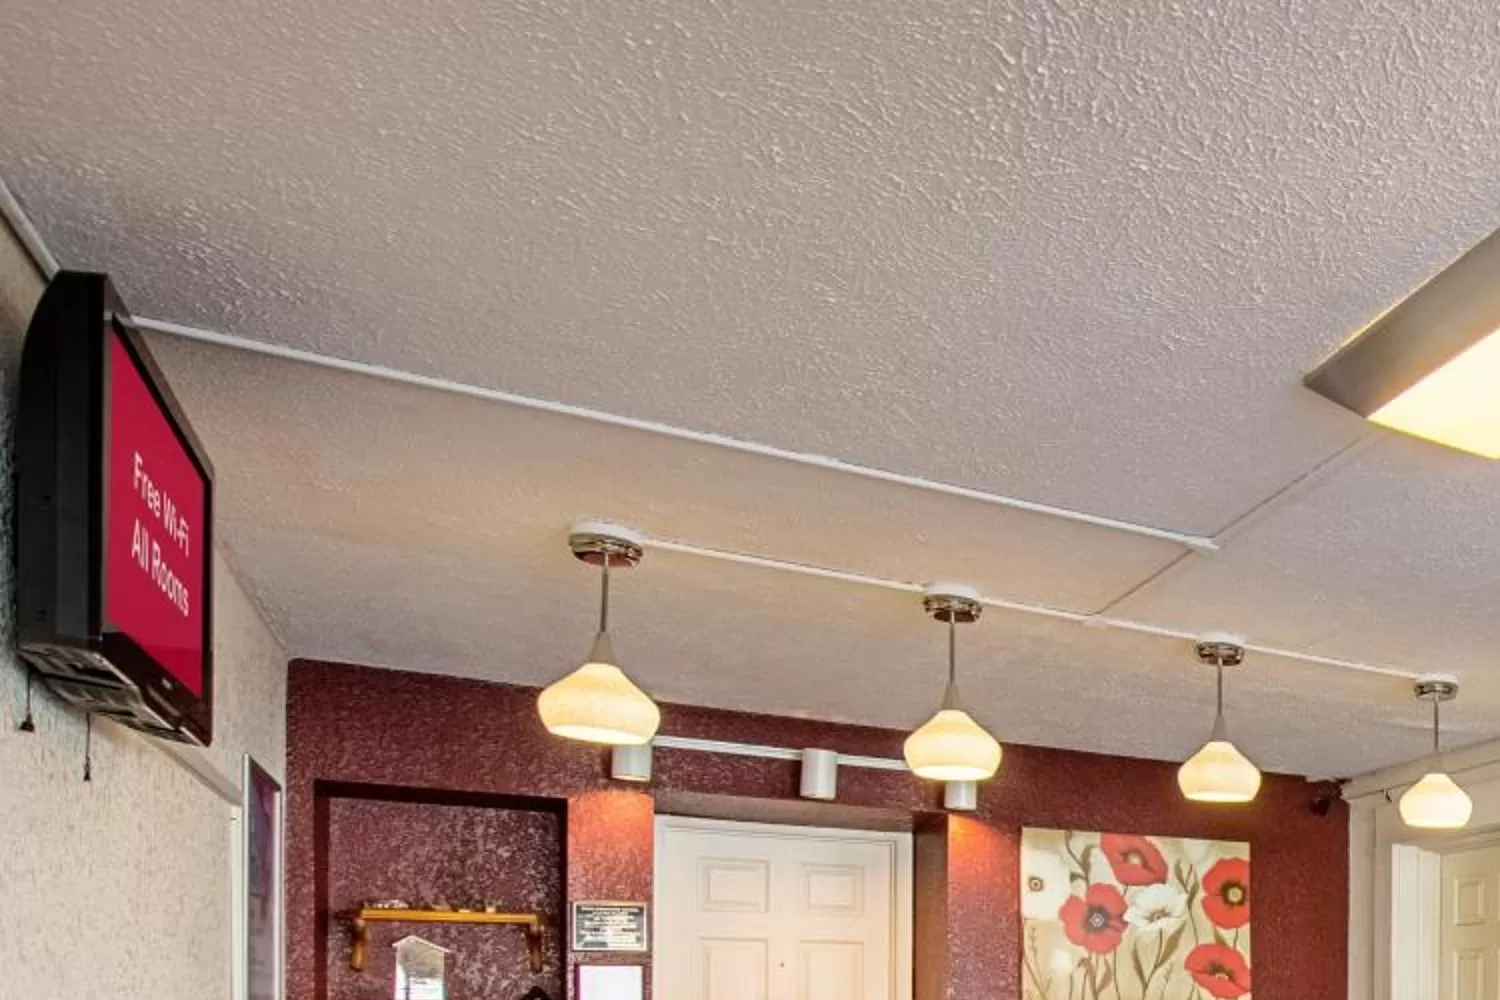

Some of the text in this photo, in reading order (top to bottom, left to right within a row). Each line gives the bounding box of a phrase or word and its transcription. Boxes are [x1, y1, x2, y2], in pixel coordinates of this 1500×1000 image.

[133, 451, 189, 559] Free Wi-Fi
[131, 517, 189, 617] All Rooms
